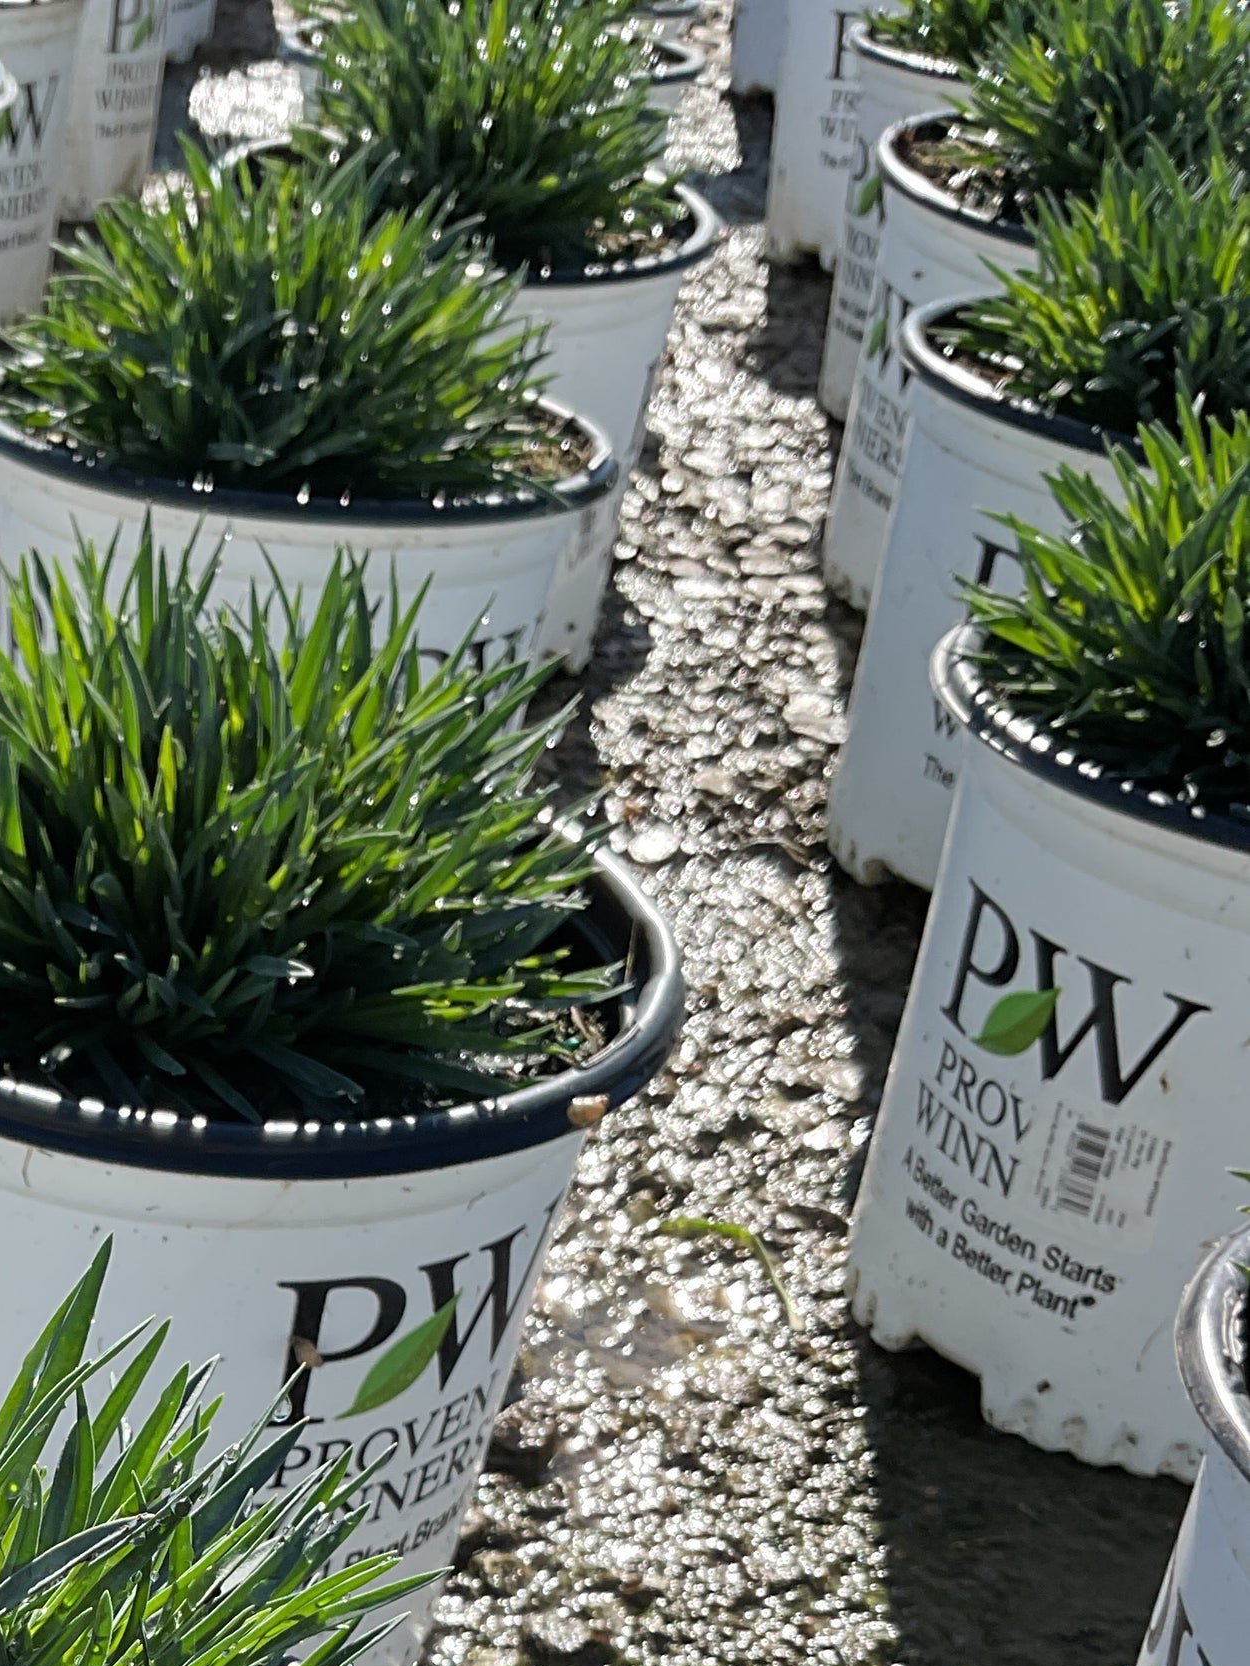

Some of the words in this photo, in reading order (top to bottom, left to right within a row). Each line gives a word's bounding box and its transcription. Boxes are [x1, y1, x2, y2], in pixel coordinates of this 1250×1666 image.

[938, 877, 1212, 1108] PW
[915, 1079, 1022, 1198] WINN
[934, 1038, 1035, 1143] PROV
[901, 1145, 914, 1173] A
[913, 1153, 959, 1211] Better
[961, 1198, 1037, 1262] Garden
[1042, 1244, 1116, 1294] Starts
[905, 1196, 935, 1239] with
[936, 1226, 949, 1250] a
[951, 1231, 1014, 1287] Better
[267, 1207, 552, 1428] PW
